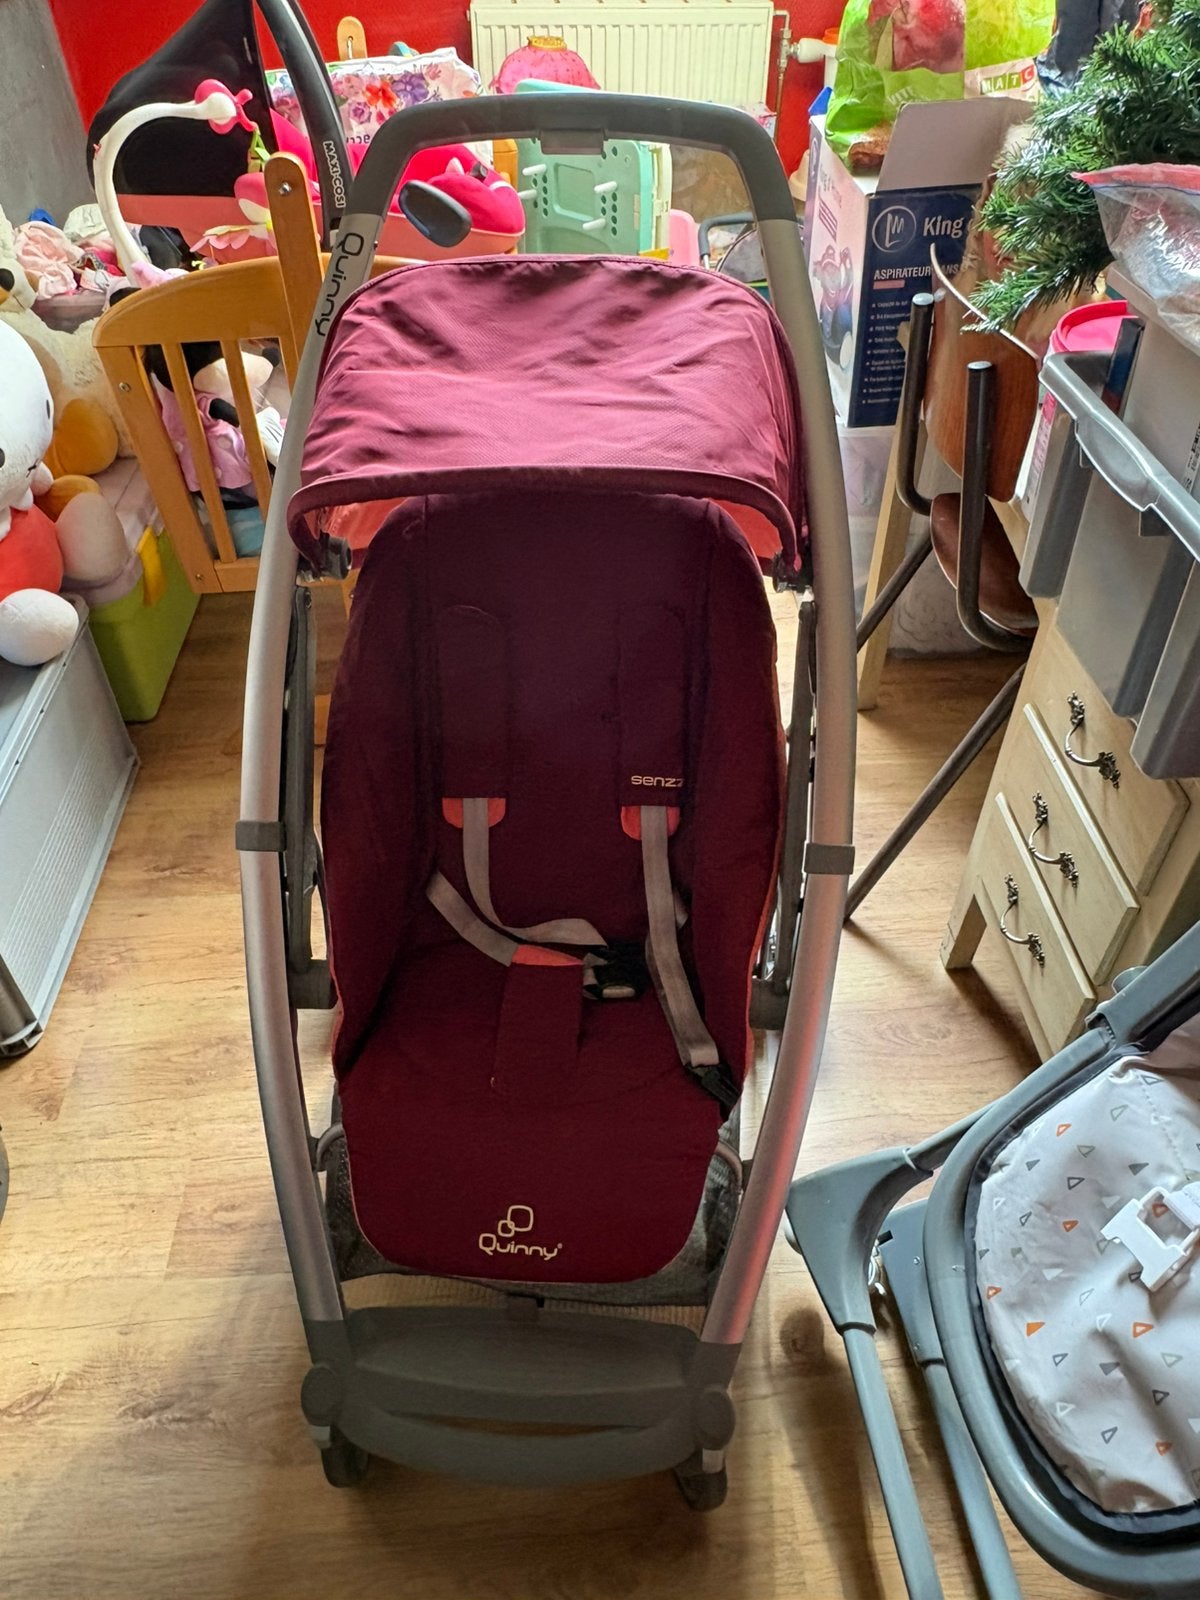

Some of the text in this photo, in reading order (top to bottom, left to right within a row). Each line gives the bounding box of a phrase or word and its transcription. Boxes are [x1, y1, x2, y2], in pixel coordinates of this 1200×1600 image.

[923, 214, 965, 239] King
[314, 232, 365, 337] Quinny
[873, 265, 931, 281] ASPIRATEUR
